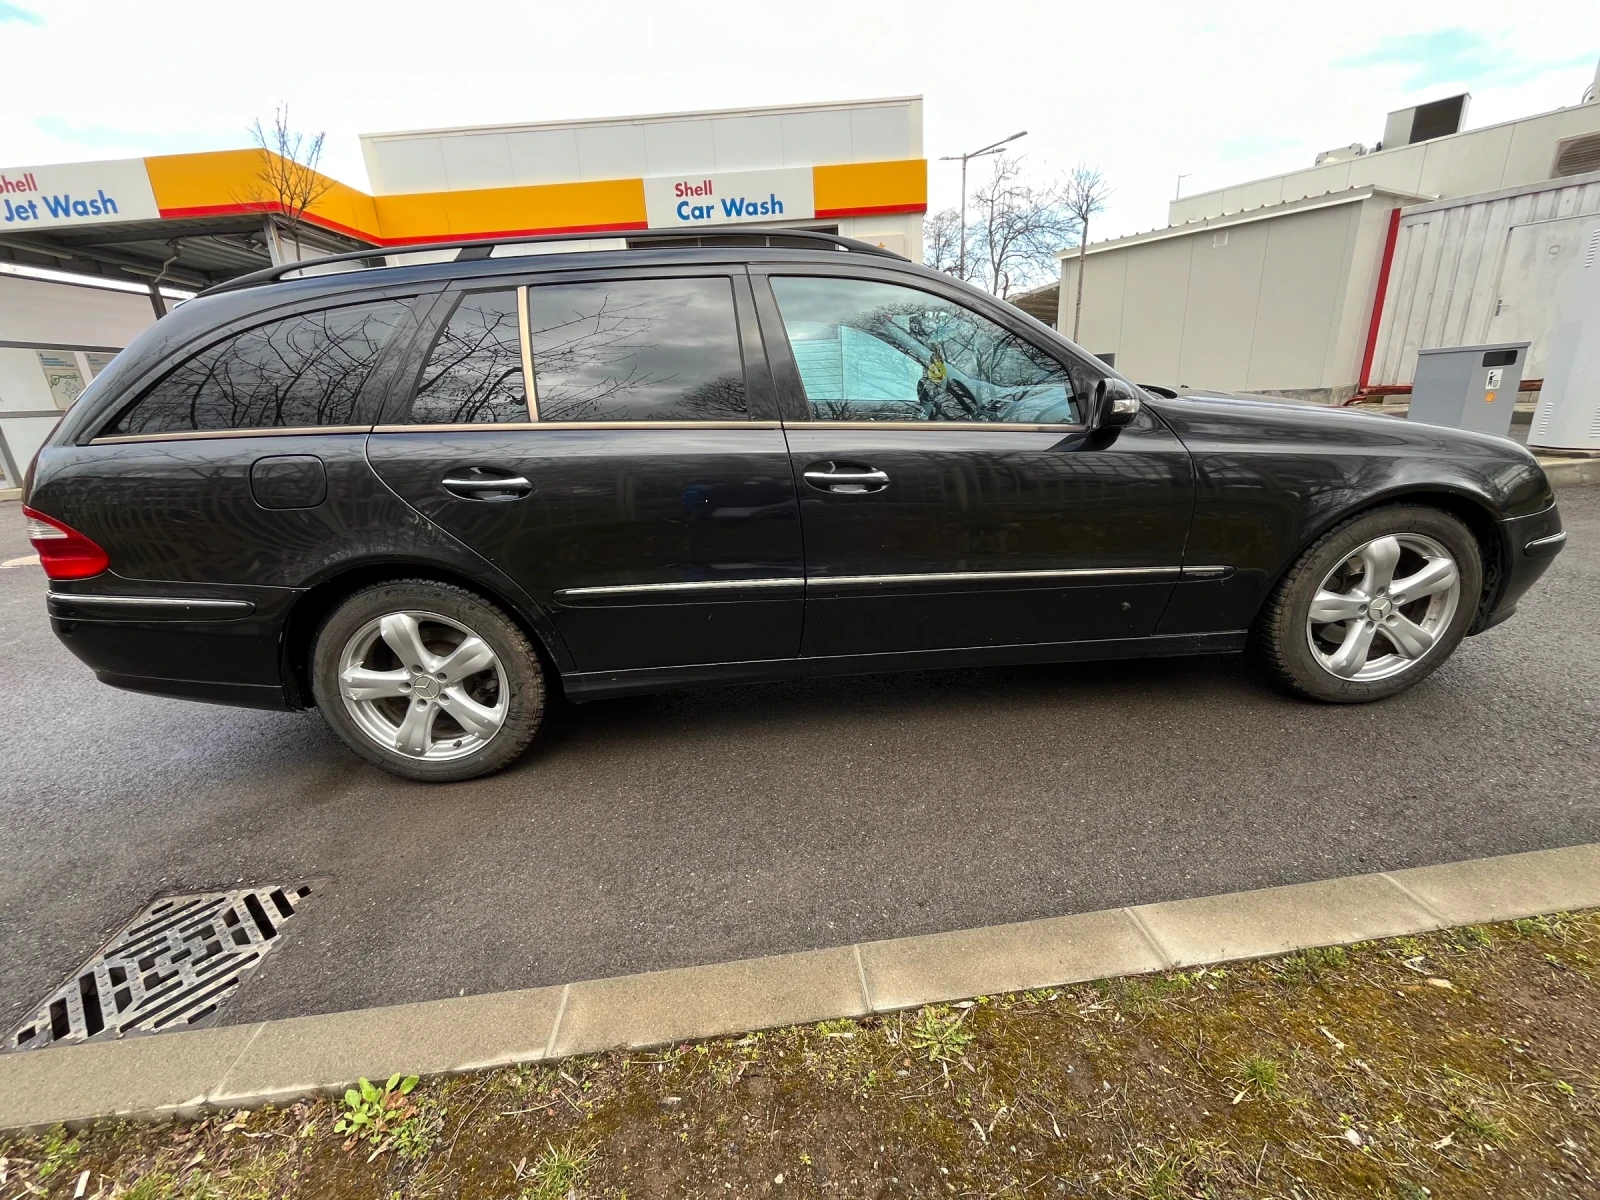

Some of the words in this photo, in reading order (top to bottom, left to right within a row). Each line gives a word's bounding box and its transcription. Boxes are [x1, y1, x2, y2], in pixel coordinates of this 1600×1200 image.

[674, 180, 713, 198] Shell
[4, 199, 39, 222] Jet
[41, 190, 119, 219] Wash
[676, 200, 715, 221] Car
[720, 194, 784, 218] Wash
